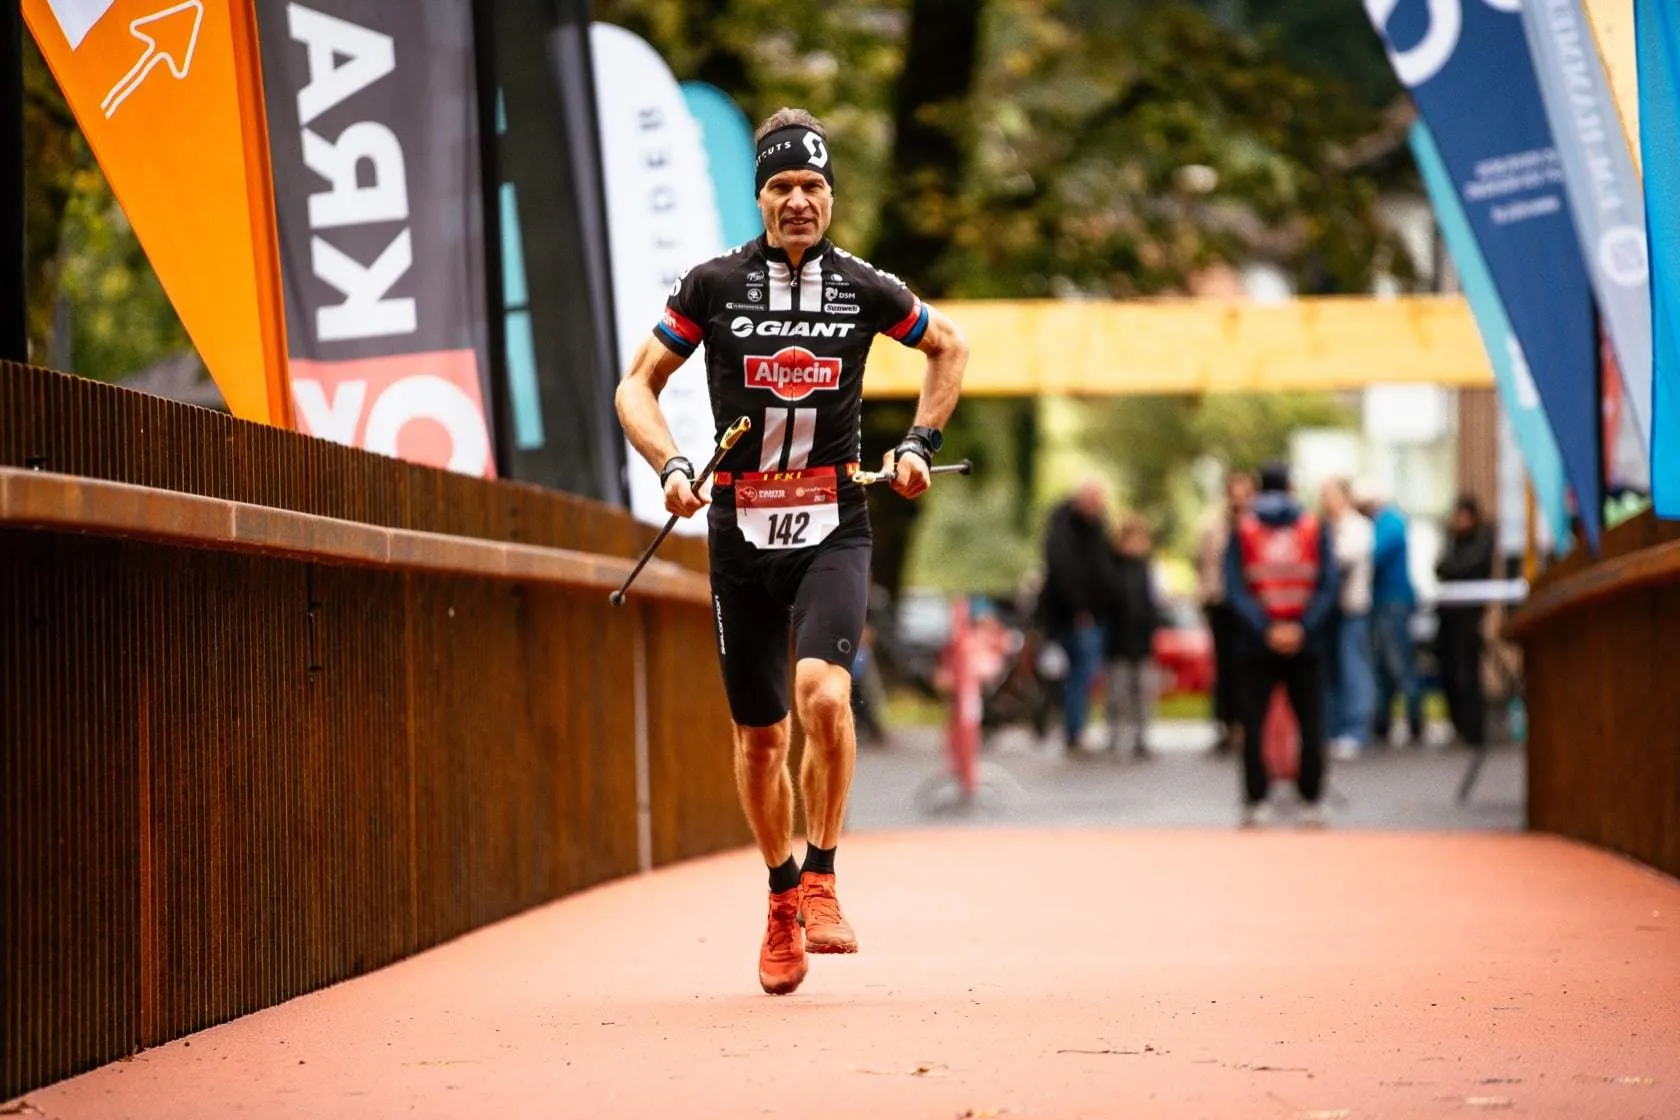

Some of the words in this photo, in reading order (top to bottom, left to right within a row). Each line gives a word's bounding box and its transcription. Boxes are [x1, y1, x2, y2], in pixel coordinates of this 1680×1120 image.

[756, 321, 855, 337] GIANT
[754, 362, 832, 388] Alpecin
[768, 512, 810, 545] 142
